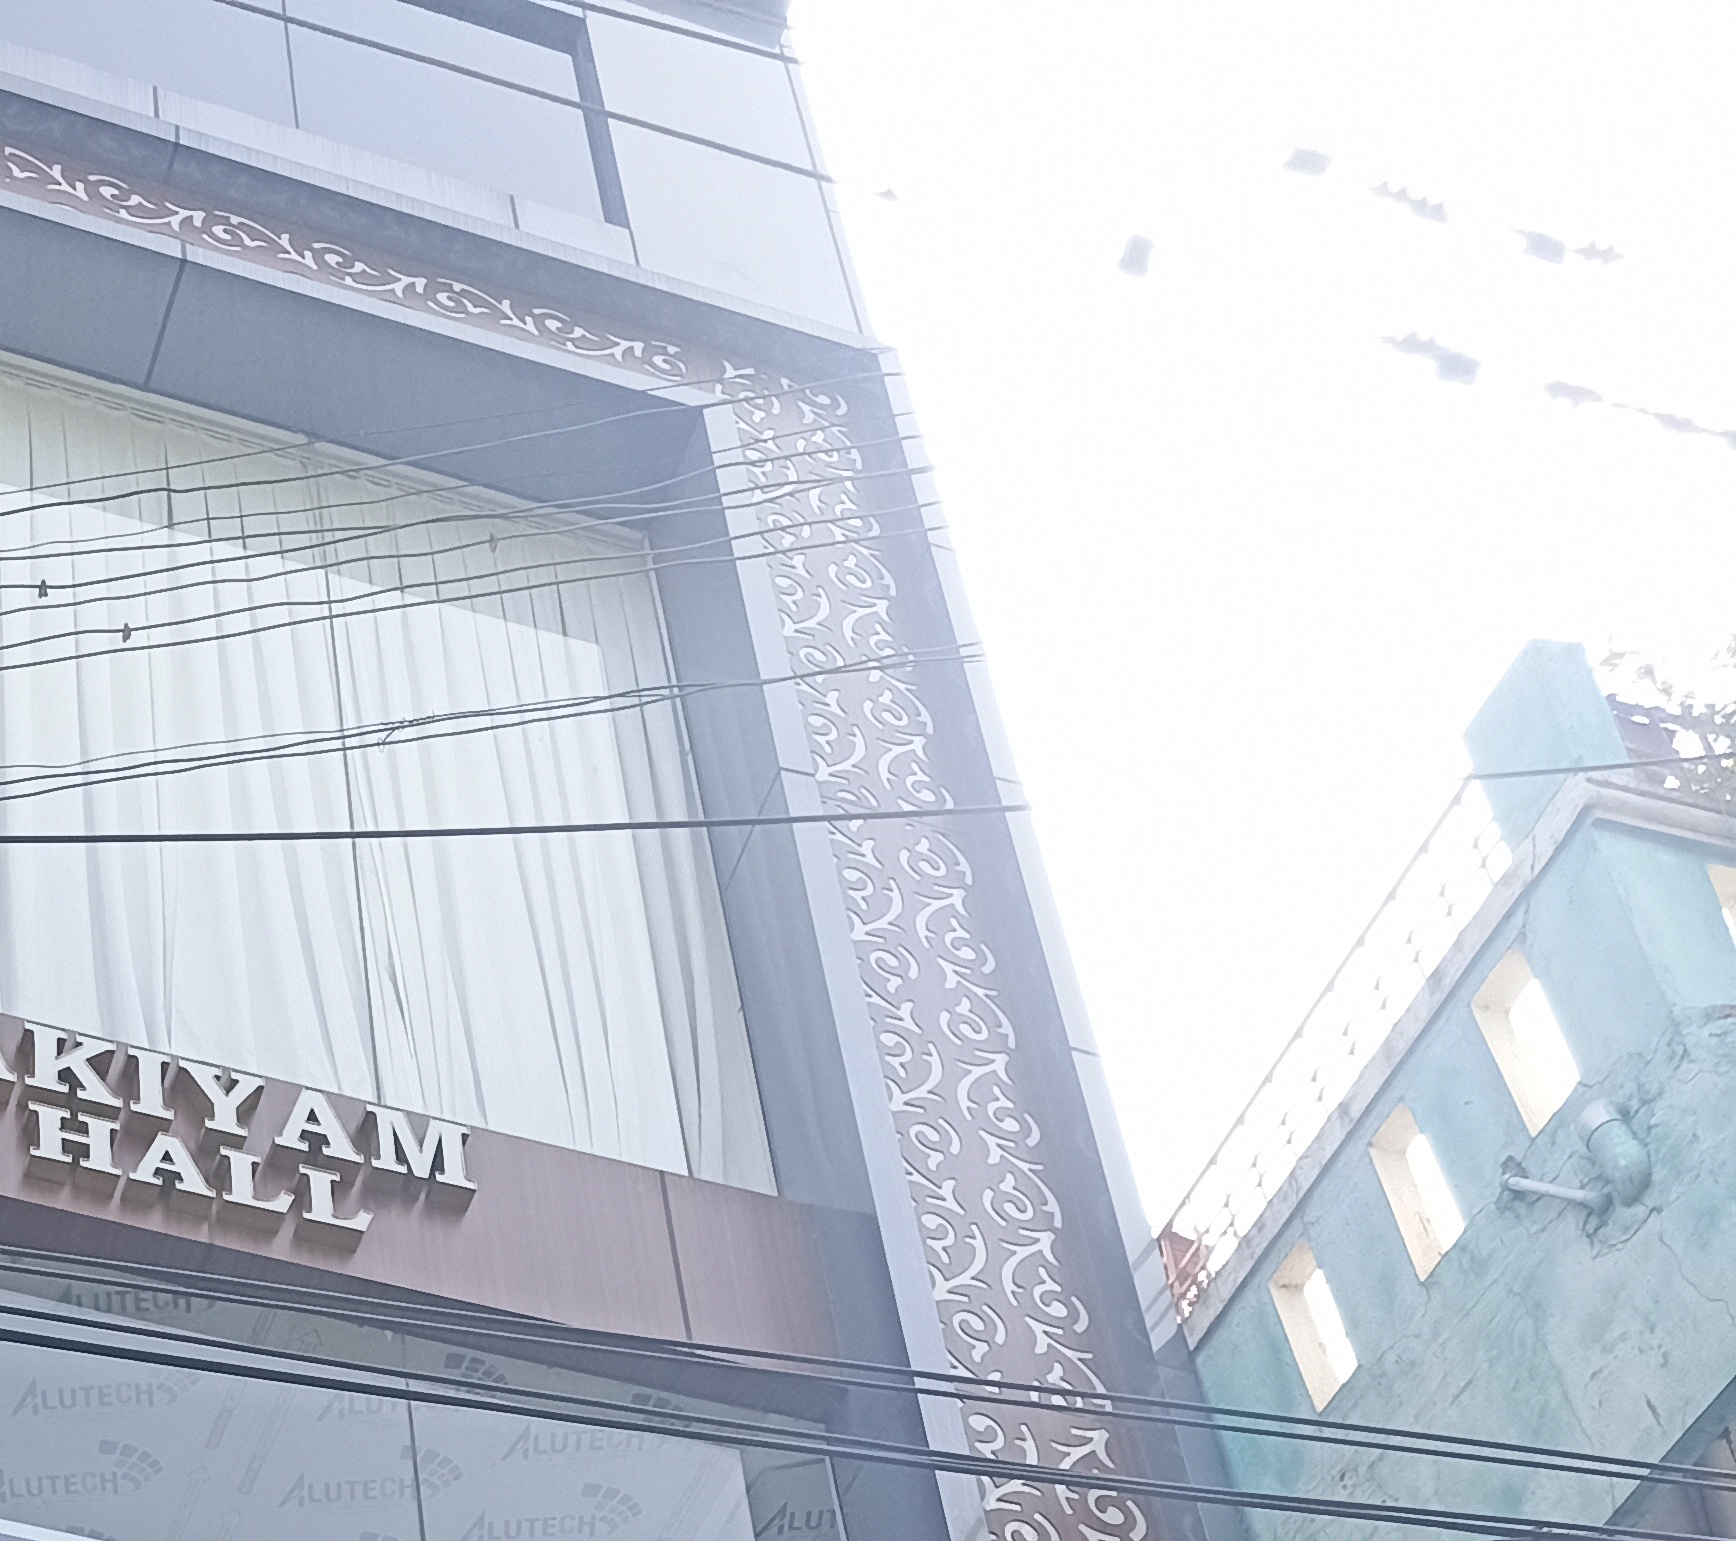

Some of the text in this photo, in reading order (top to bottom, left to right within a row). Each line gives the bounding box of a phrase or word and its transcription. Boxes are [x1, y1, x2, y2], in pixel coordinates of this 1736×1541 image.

[27, 1100, 374, 1232] HALL
[11, 1376, 156, 1418] ALUTECH
[500, 1423, 644, 1462] ALUTECH
[278, 1472, 416, 1508] ALUTECH
[755, 1501, 839, 1538] ALUT
